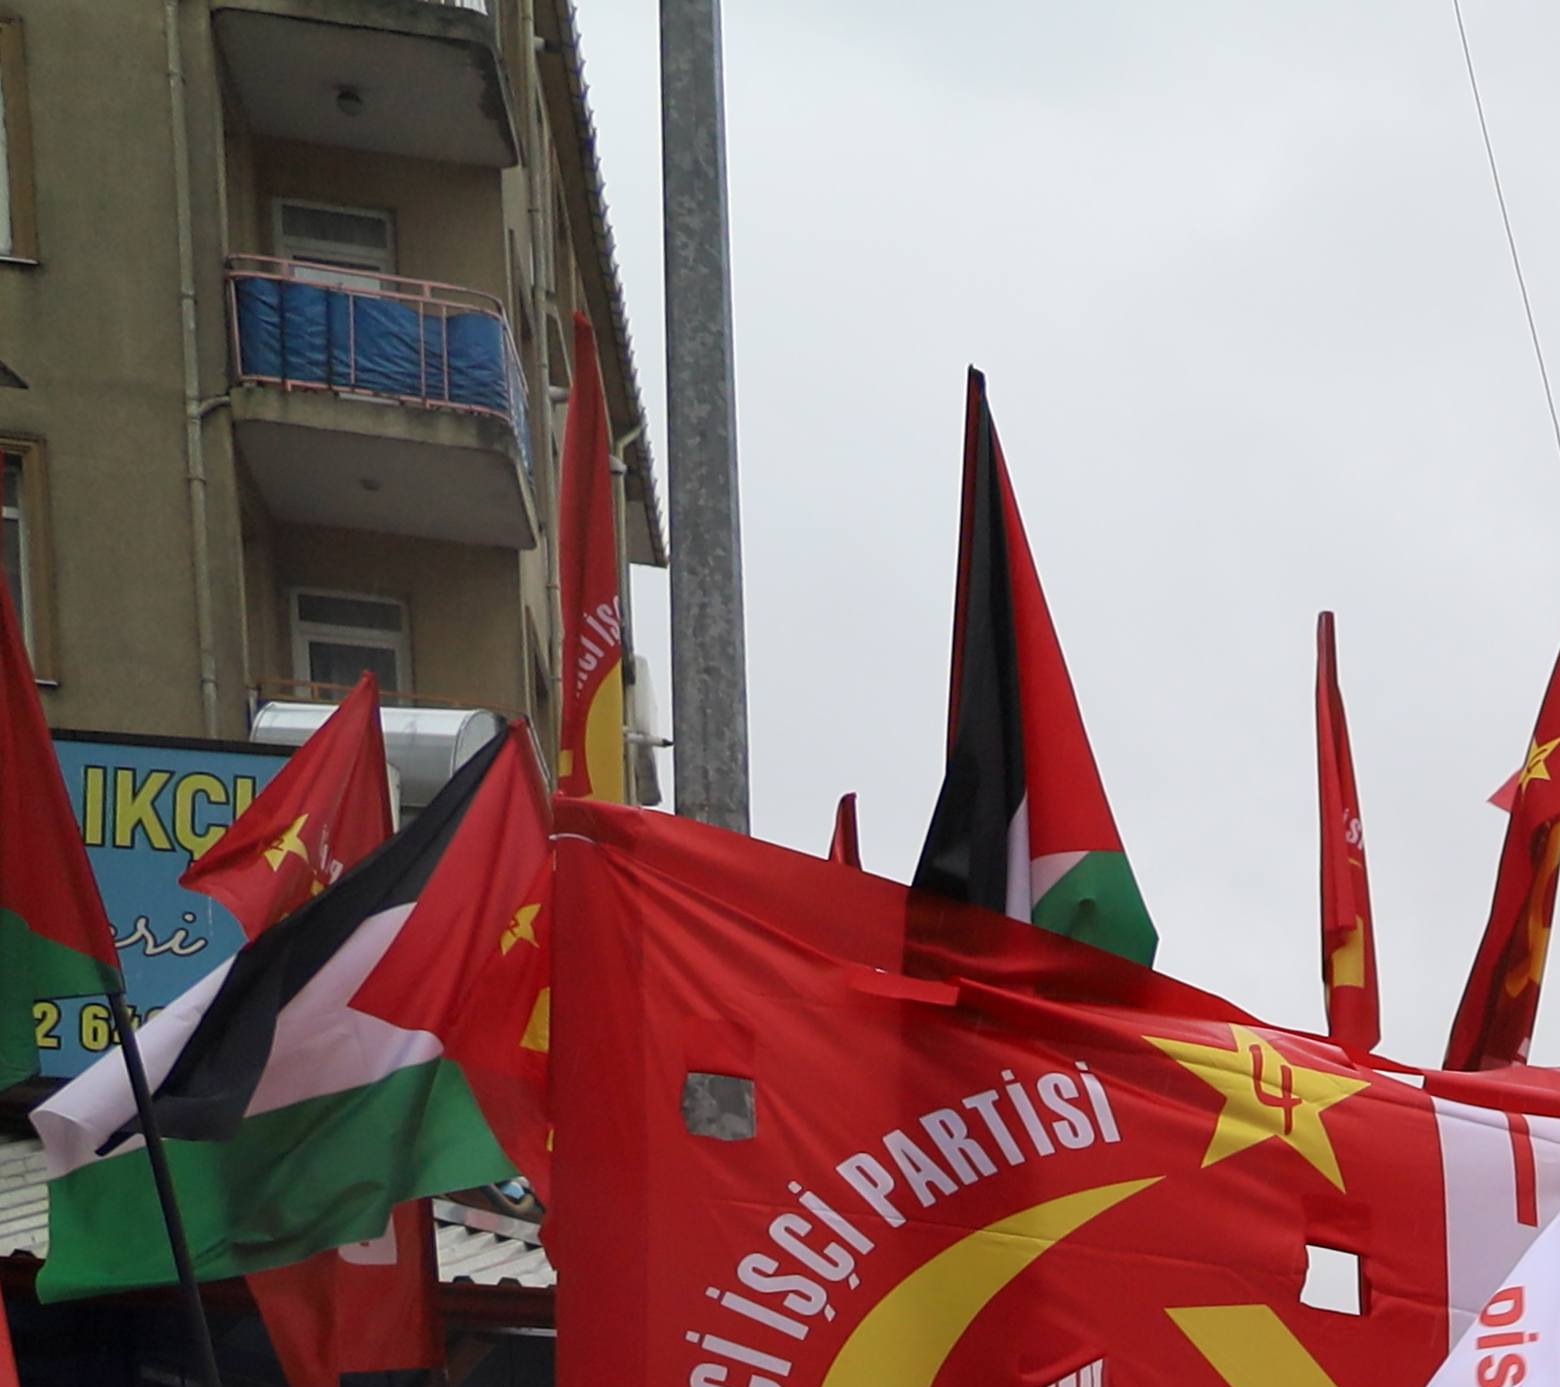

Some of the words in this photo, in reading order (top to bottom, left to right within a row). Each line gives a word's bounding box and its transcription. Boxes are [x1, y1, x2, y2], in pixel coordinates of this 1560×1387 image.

[83, 766, 257, 862] IKÇI
[705, 1180, 875, 1340] İŞÇİ
[836, 1061, 1121, 1228] PARTİSİ
